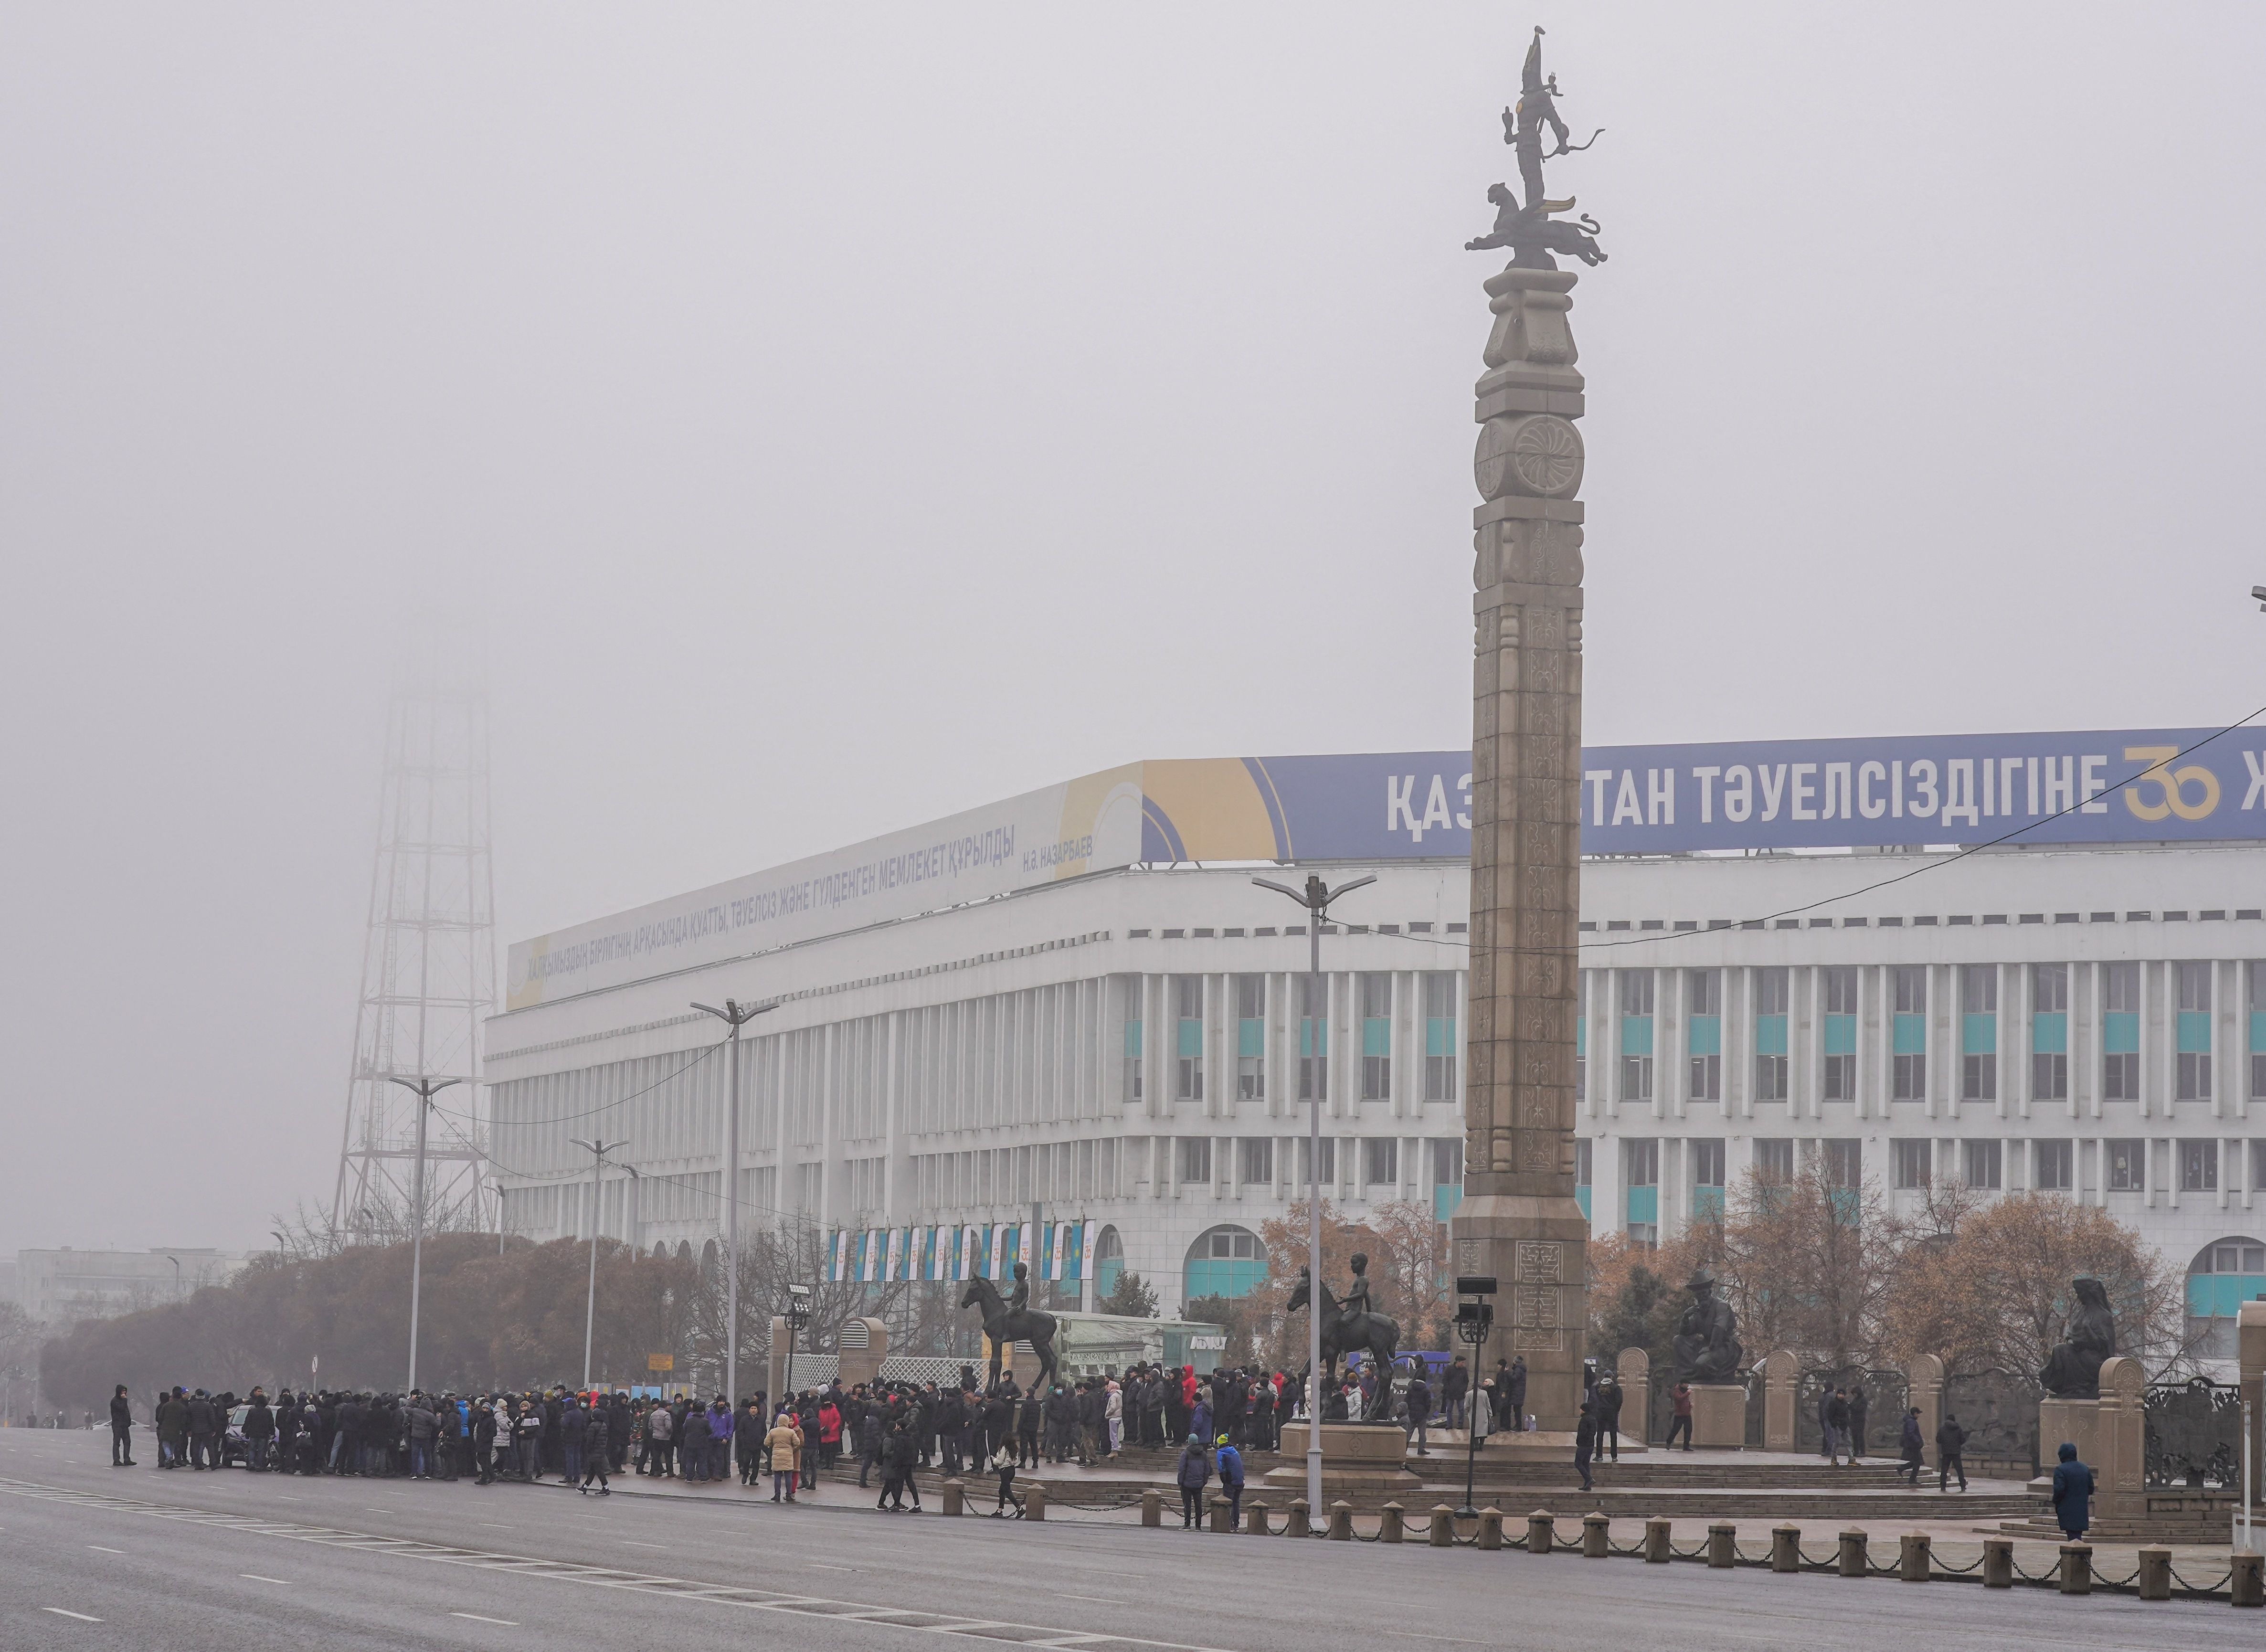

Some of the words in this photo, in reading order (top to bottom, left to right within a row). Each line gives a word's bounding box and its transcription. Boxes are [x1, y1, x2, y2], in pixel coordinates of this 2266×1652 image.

[1387, 769, 1675, 842] ҚАЗТАН
[1693, 755, 2107, 826] ТӘУЕЛСІЗДІГІНЕ
[2123, 745, 2221, 821] 30
[1041, 835, 1092, 868] НАЗАРБАЕВ
[528, 942, 588, 982] ХАЛҚЫМЫЗДЫҢ
[590, 931, 632, 965] БІРЛІГІНІҢ
[634, 915, 688, 954] АРҚАСЫНДА
[690, 904, 729, 943] ҚУАТТЫ,
[731, 890, 777, 929] ТӘУЕЛСІЗ
[779, 881, 810, 916] ЖӘНЕ
[813, 863, 875, 909] ГҮЛДЕНГЕН
[879, 844, 946, 890] МЕМЛЕКЕТ
[949, 824, 1014, 878] ҚҰРЫЛДЫ
